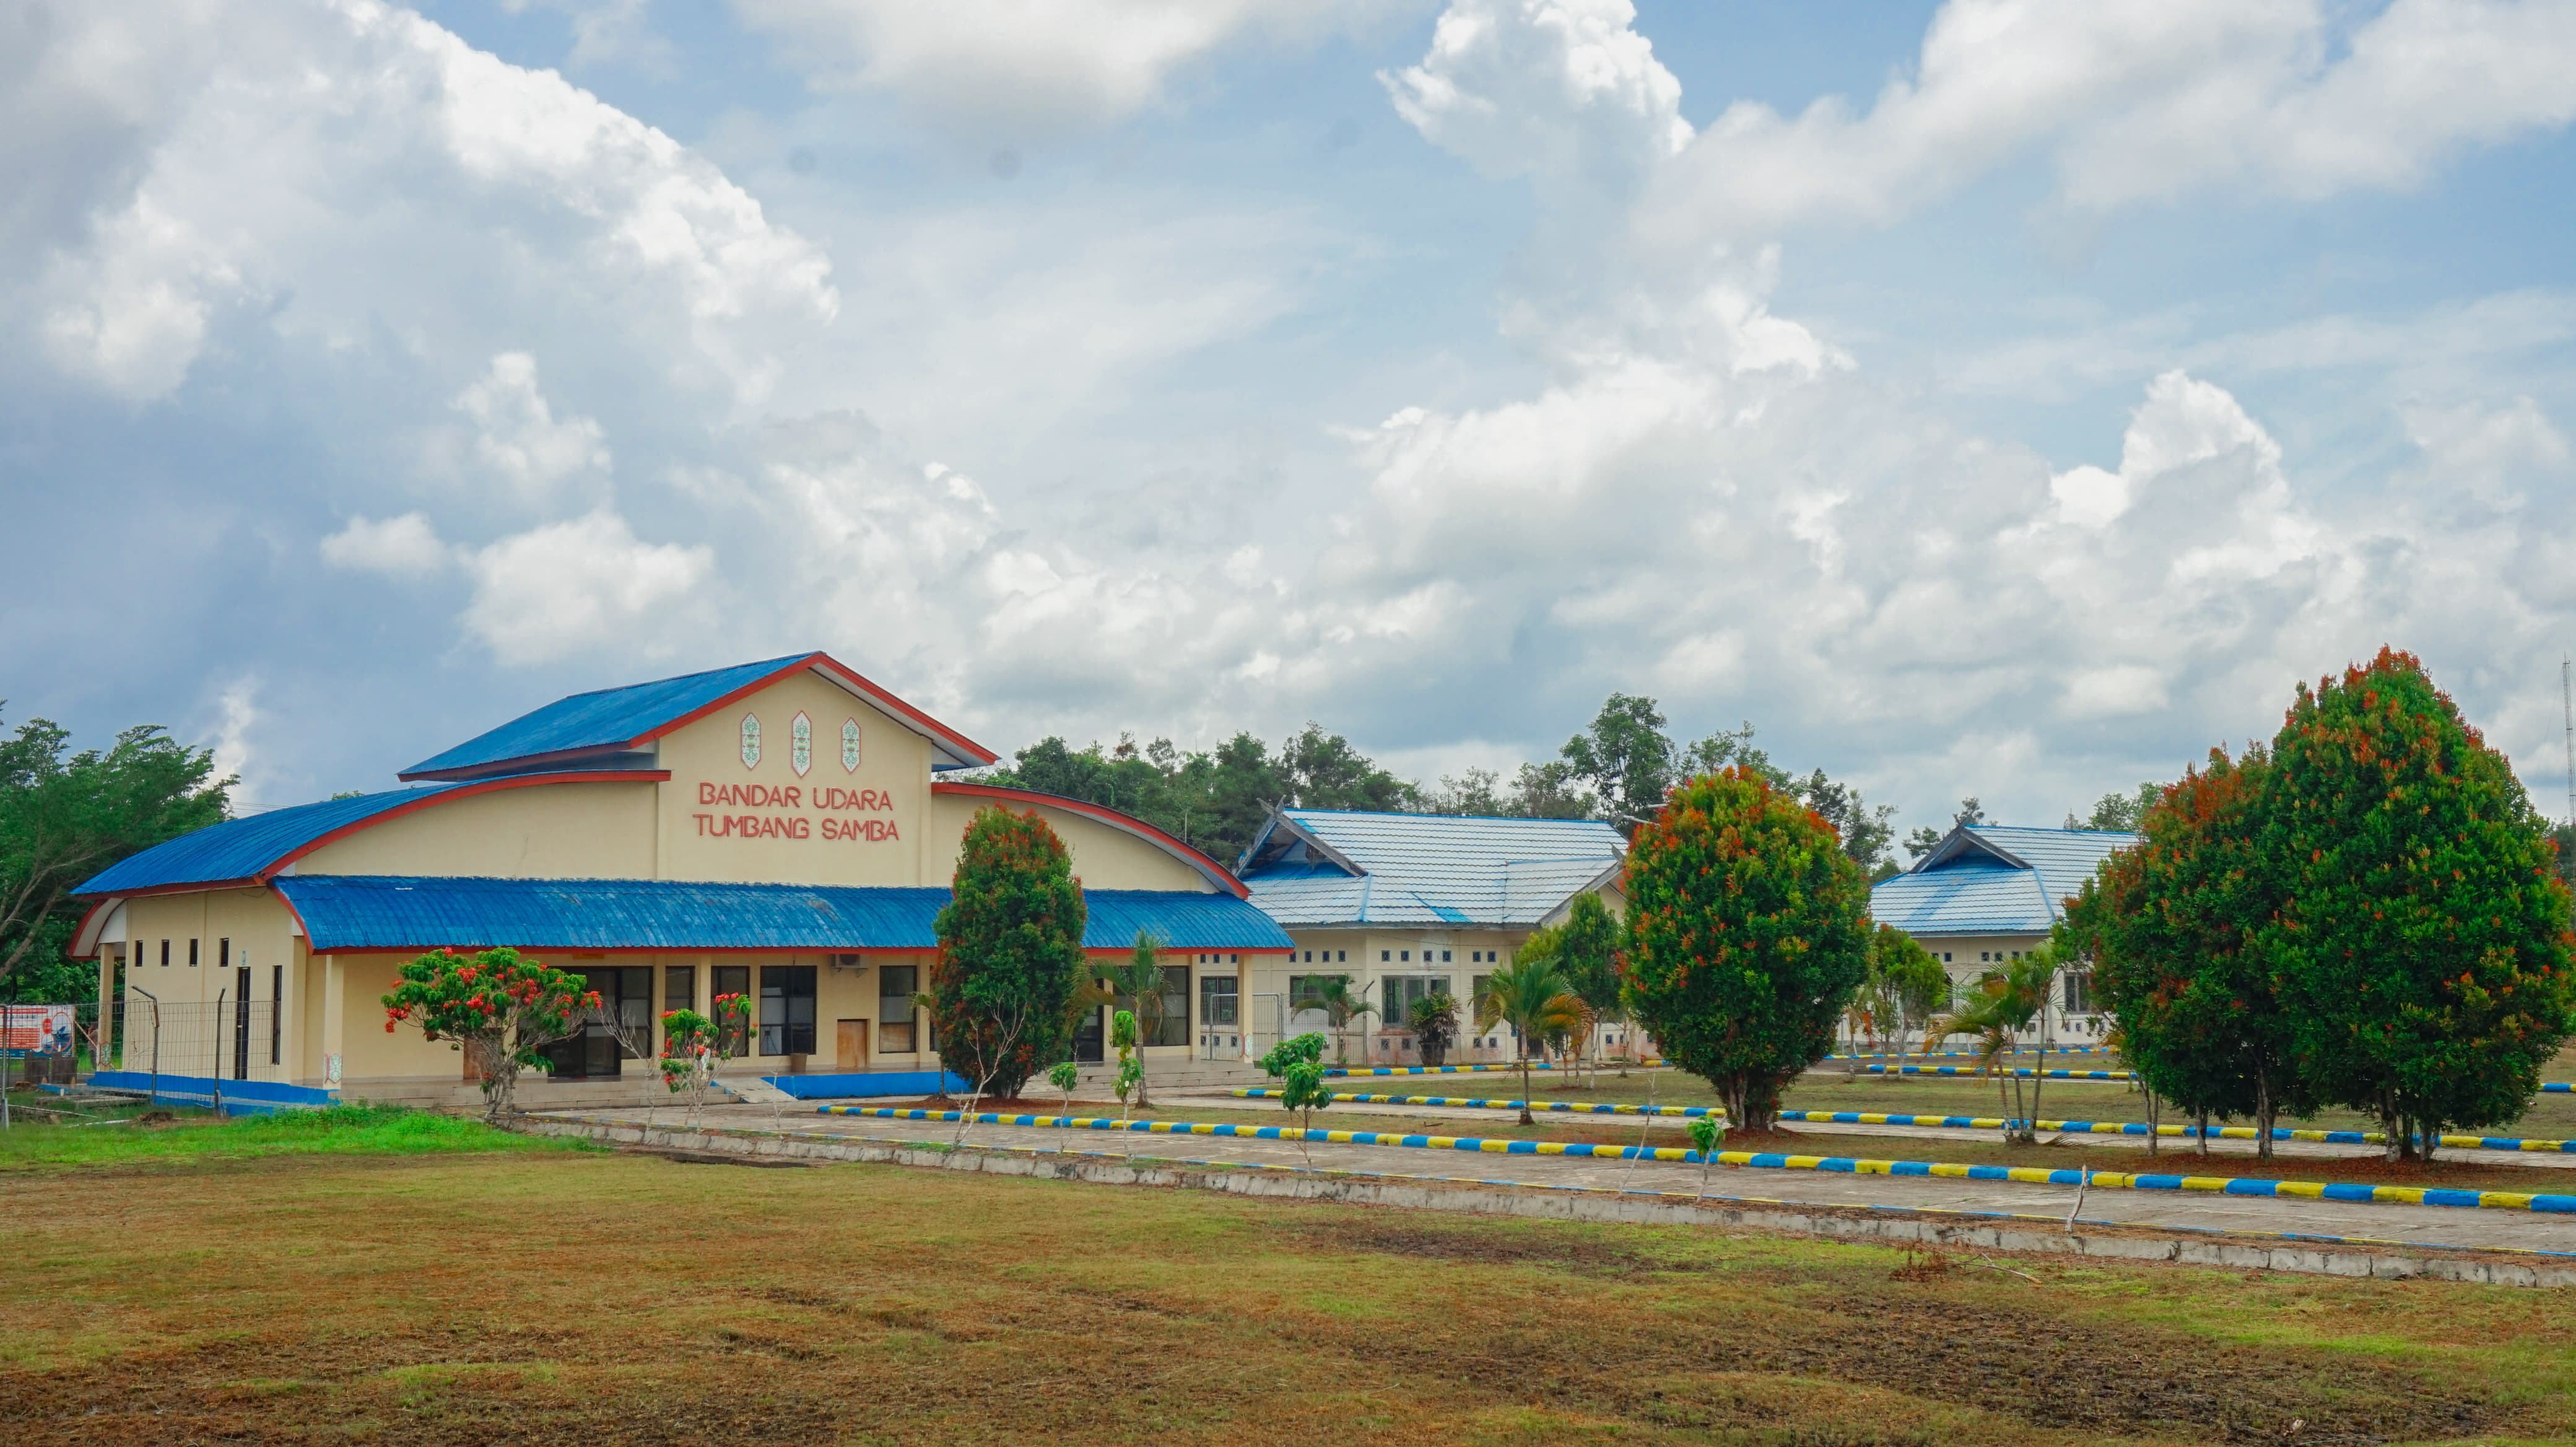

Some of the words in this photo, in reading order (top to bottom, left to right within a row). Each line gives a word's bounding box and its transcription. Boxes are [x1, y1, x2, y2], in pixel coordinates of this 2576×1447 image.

[700, 782, 801, 808] BANDAR
[814, 787, 893, 811] UDARA
[693, 814, 809, 839] TUMBANG
[822, 818, 899, 841] SAMBA
